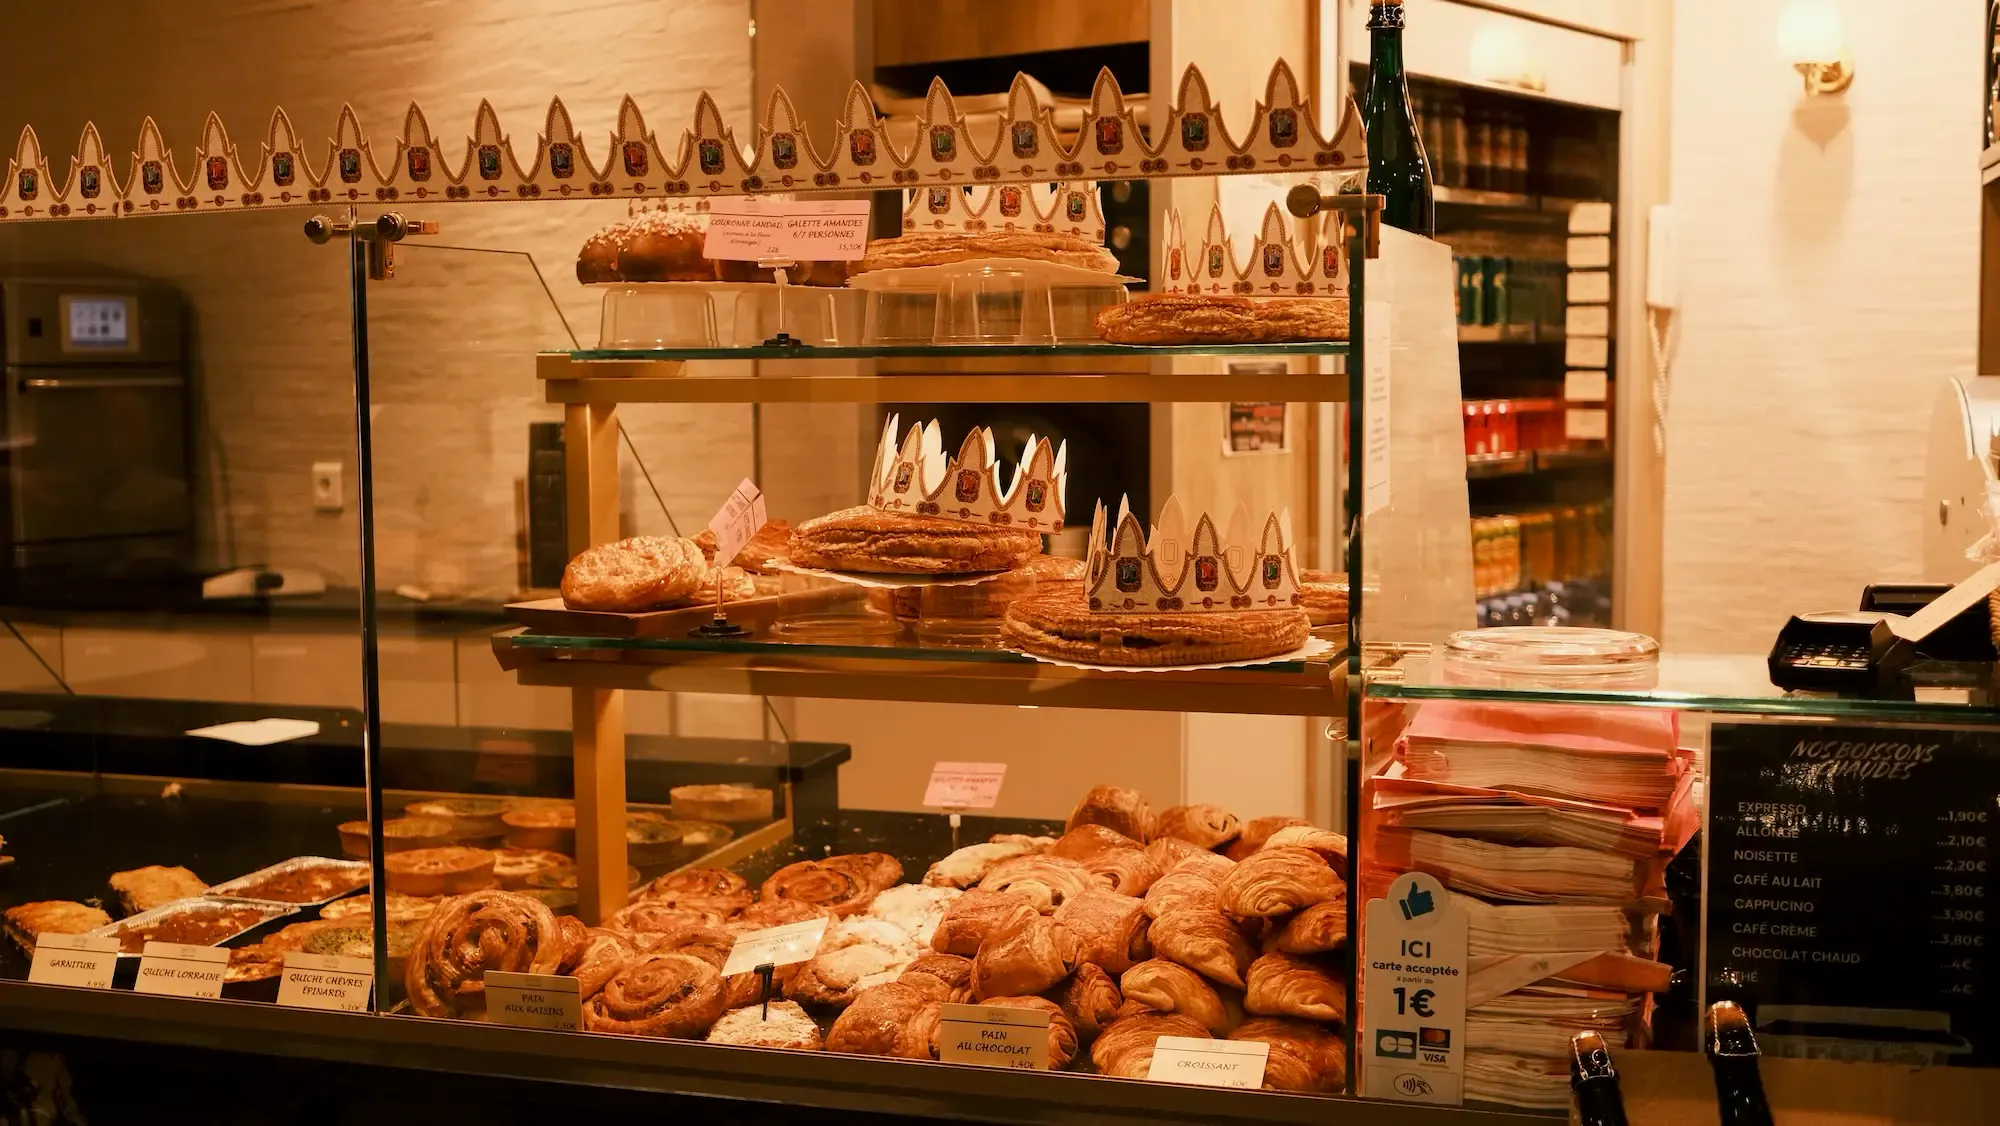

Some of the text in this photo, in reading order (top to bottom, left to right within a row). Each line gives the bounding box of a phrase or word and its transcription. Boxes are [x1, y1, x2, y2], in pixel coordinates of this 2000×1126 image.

[710, 219, 750, 228] COURONNE
[787, 219, 863, 228] GALETTE AMANDES
[792, 230, 855, 239] 6/7 PERSONNES
[1790, 740, 1940, 763] NOS BOISSONS
[1818, 760, 1918, 780] CHAUDES
[1738, 801, 1806, 815] EXPRESSO
[1734, 850, 1798, 863] NOISETTE
[1733, 873, 1768, 886] CAFÉ
[1771, 876, 1791, 886] AU
[1793, 877, 1822, 889] LAIT
[1734, 898, 1814, 912] CAPPUCINO
[1732, 921, 1767, 934] CAFÉ
[1770, 924, 1817, 938] CRÈME
[1401, 940, 1431, 958] ICI
[1732, 946, 1808, 962] CHOCOLAT
[1811, 951, 1861, 964] CHAUD
[50, 959, 97, 970] GARNITURE
[1372, 961, 1459, 977] carte acceptée
[142, 967, 221, 982] QUICHE LORRAINE
[289, 973, 364, 988] QUICHE CHÈVRES
[1402, 977, 1422, 985] partir
[302, 985, 347, 999] ÉPINARDS
[521, 994, 545, 1004] PAIN
[1392, 987, 1436, 1018] 1€
[505, 1004, 564, 1017] AUX RAISINS
[981, 1030, 1007, 1040] PAIN
[956, 1041, 1032, 1055] AU CHOCOLAT
[1424, 1053, 1446, 1063] VISA
[1177, 1060, 1240, 1072] CROISSANT
